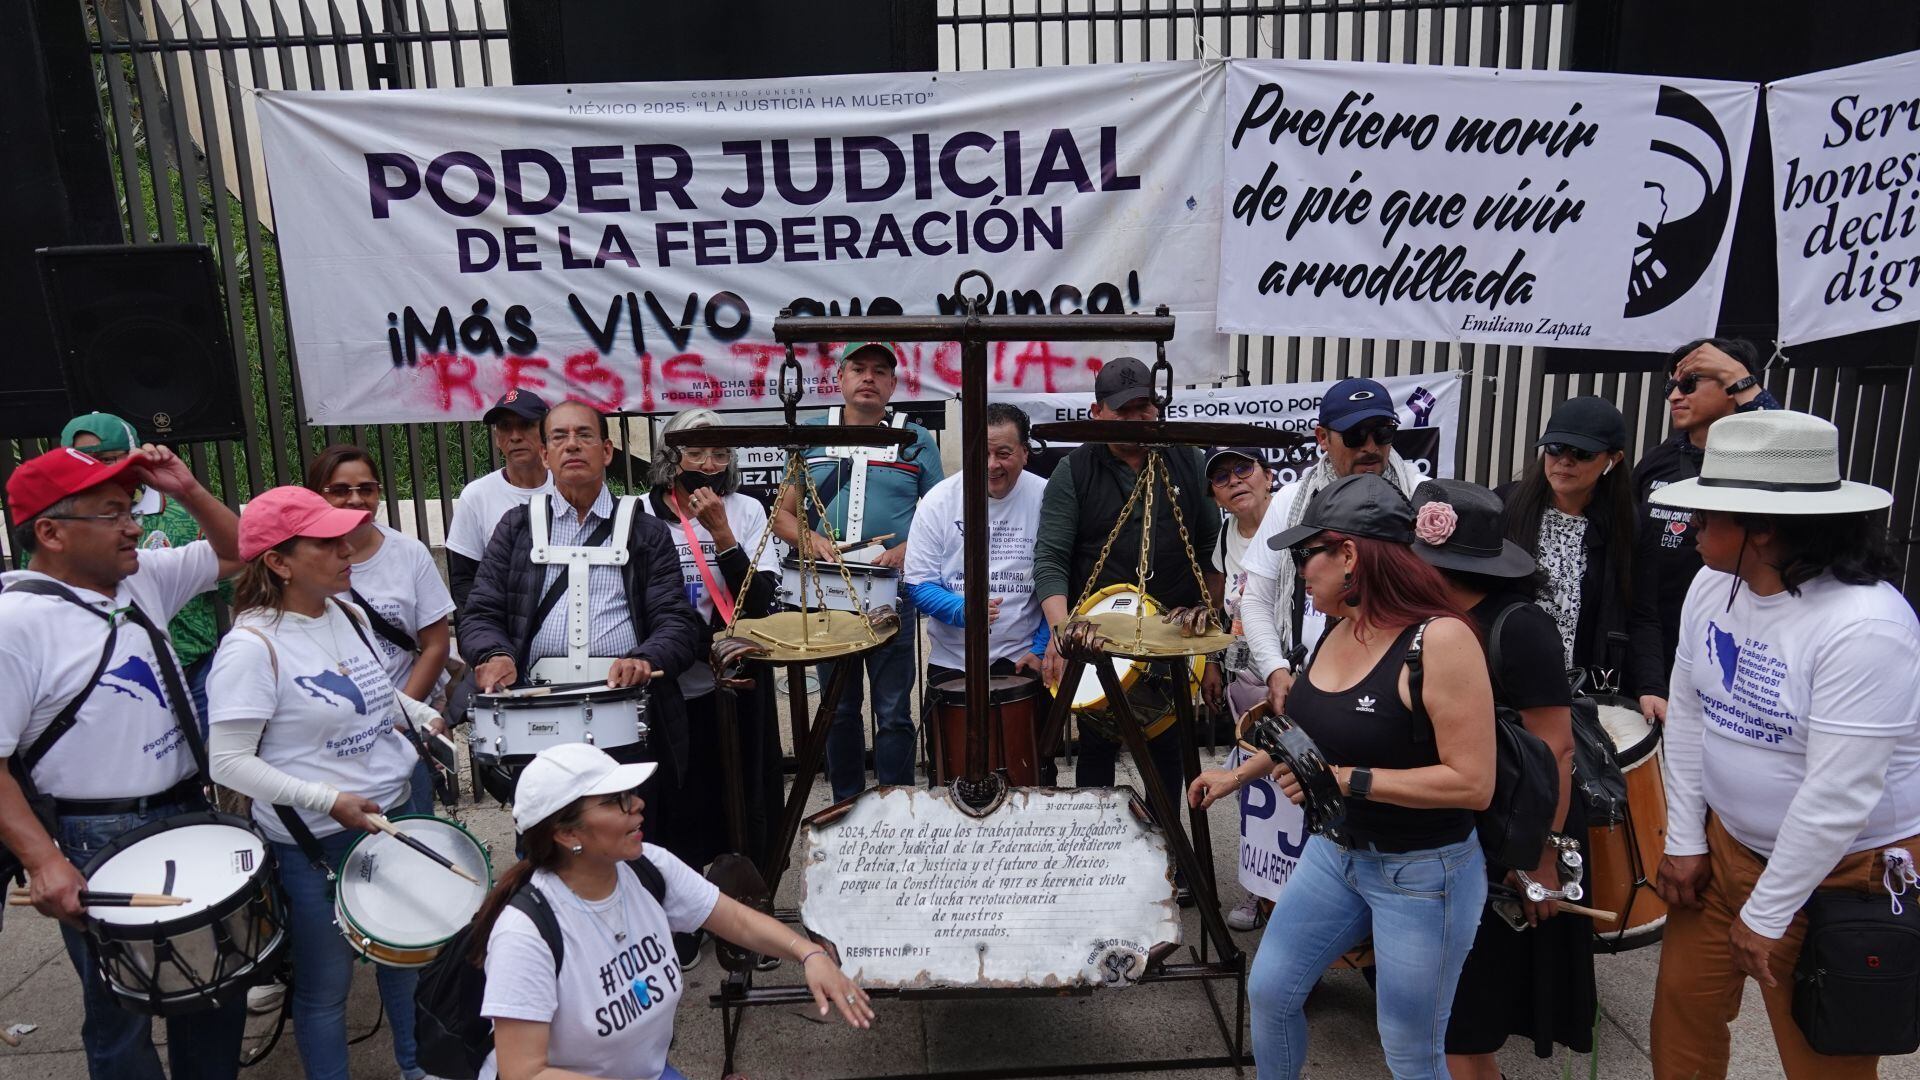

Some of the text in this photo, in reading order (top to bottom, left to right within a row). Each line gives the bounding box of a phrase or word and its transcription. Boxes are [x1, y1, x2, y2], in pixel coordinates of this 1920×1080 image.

[569, 101, 637, 115] MÉXICO
[643, 102, 691, 114] 2025:
[733, 97, 816, 112] JUSTICIA
[822, 96, 846, 109] HA
[1232, 82, 1599, 158] Prefiero morir
[364, 126, 1141, 219] PODER JUDICIAL
[1783, 152, 1920, 211] hones
[1233, 161, 1586, 250] de pie que vivir
[456, 195, 1063, 274] DE LA FEDERACIÓN
[1257, 243, 1537, 312] arrodillada
[567, 289, 752, 356] VIVO
[1460, 314, 1592, 340] Emiliano Zapata
[692, 380, 745, 390] MARCHA
[769, 376, 828, 388] DFNSA
[661, 390, 703, 401] PODER
[707, 387, 763, 399] JUDICIAL
[1193, 401, 1231, 417] POR
[1235, 399, 1284, 415] VOTO
[1000, 572, 1024, 580] AMPARO
[1741, 648, 1767, 663] trabaja
[1753, 641, 1769, 652] PJF
[1738, 656, 1786, 679] defender tus
[1732, 693, 1747, 705] para
[1733, 684, 1778, 707] defendernos
[1747, 681, 1759, 691] nos
[1760, 686, 1781, 699] toca
[1696, 688, 1793, 736] #soypoderjudicial
[531, 723, 555, 733] Century
[1703, 705, 1785, 744] #respetoalPJF
[869, 820, 896, 839] Año
[900, 827, 914, 839] en
[931, 827, 951, 843] que
[954, 823, 972, 839] los
[976, 820, 1055, 839] trabajadores
[1056, 826, 1067, 842] y
[1066, 818, 1128, 842] Juzgadores
[839, 840, 857, 855] del
[859, 841, 895, 856] Poder
[897, 840, 949, 856] Judicial
[952, 839, 966, 854] de
[971, 840, 985, 854] la
[1057, 838, 1123, 855] defendieron
[837, 860, 850, 873] la
[854, 856, 899, 873] Patria,
[901, 859, 915, 873] la
[918, 856, 967, 875] Justicia
[970, 861, 980, 875] y
[983, 857, 994, 871] el
[994, 855, 1038, 876] futuro
[1043, 855, 1058, 869] de
[839, 872, 1127, 895] porque la Constitución de 1917 es herencia viva
[895, 889, 1058, 907] de la lucha revolucionaria
[931, 906, 1004, 922] de nuestros
[934, 923, 1010, 940] antepasados.
[846, 945, 908, 958] RESISTENCIA
[1121, 939, 1150, 957] UNIDOS
